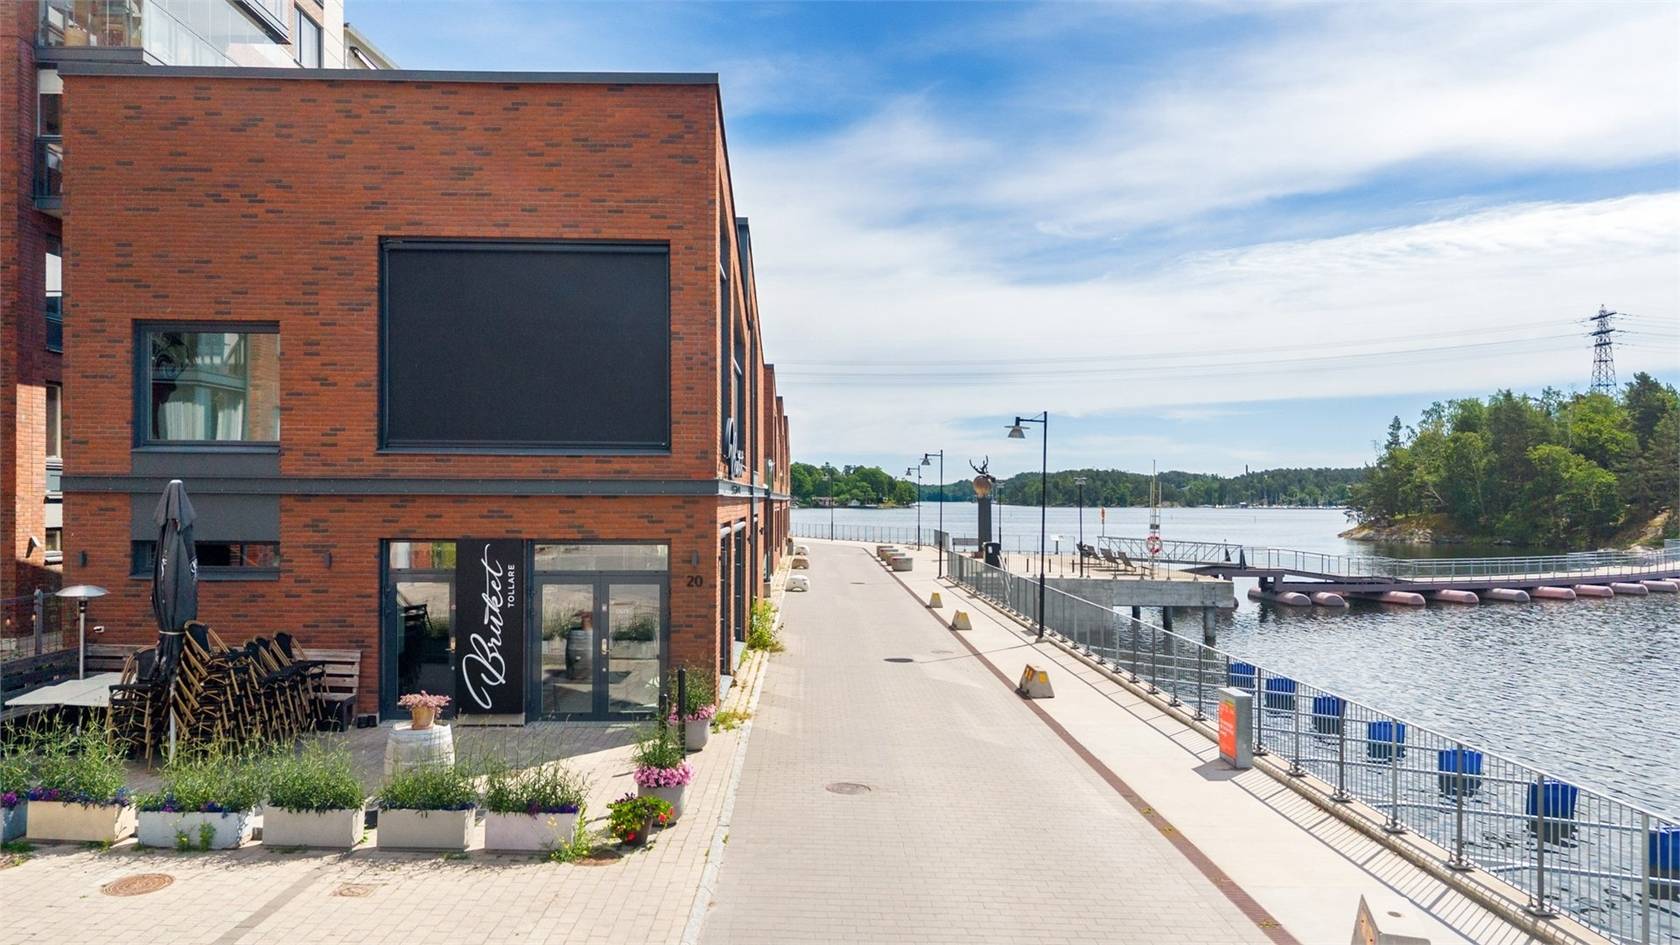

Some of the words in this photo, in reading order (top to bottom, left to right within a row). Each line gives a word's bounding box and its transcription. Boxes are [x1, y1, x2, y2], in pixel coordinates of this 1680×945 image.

[507, 564, 516, 608] TOLLARE
[686, 575, 704, 588] 20
[462, 543, 506, 709] Bruket
